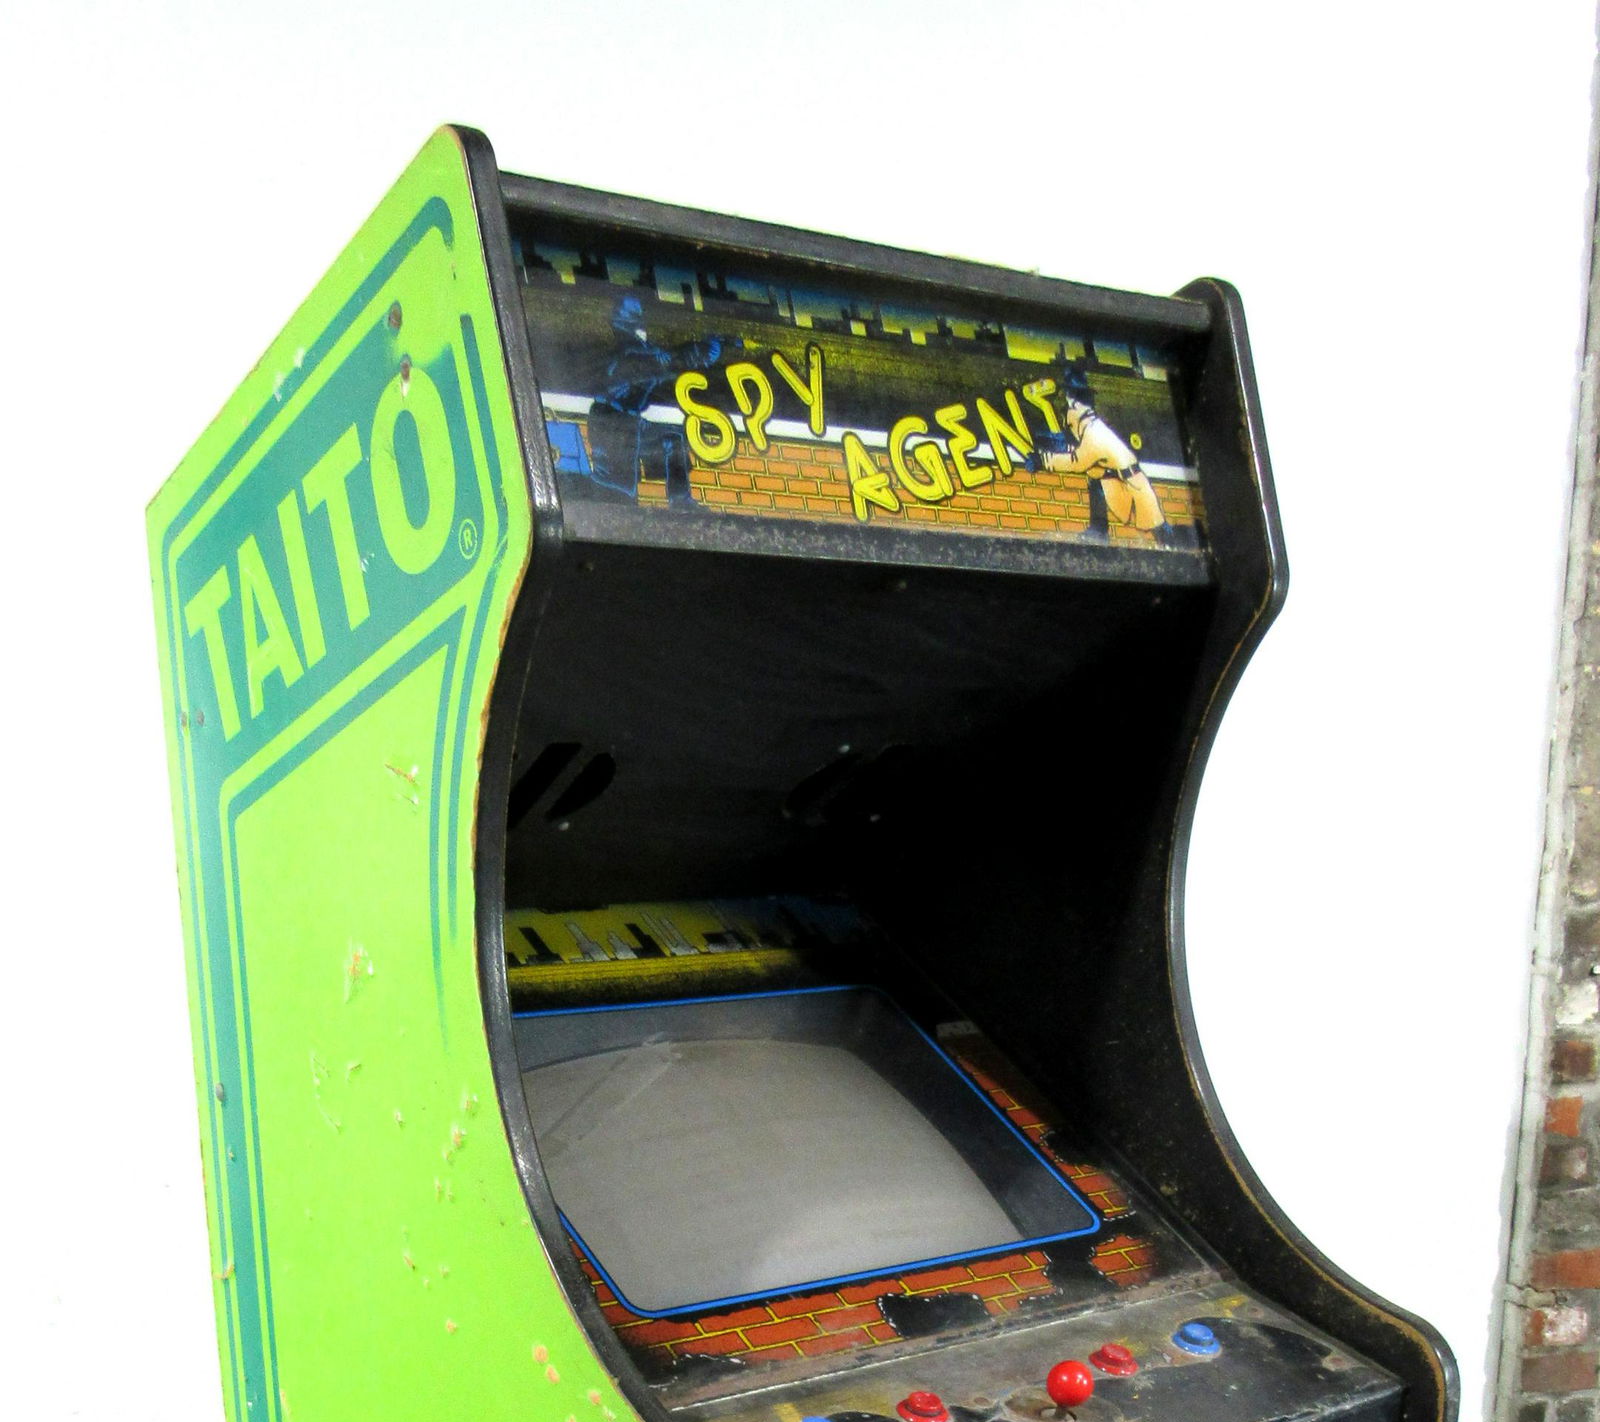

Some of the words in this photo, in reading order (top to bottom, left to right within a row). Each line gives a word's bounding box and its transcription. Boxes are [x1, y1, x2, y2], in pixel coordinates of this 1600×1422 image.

[675, 343, 824, 462] SPY
[842, 378, 1061, 521] AGENT
[184, 366, 455, 742] TAITO
